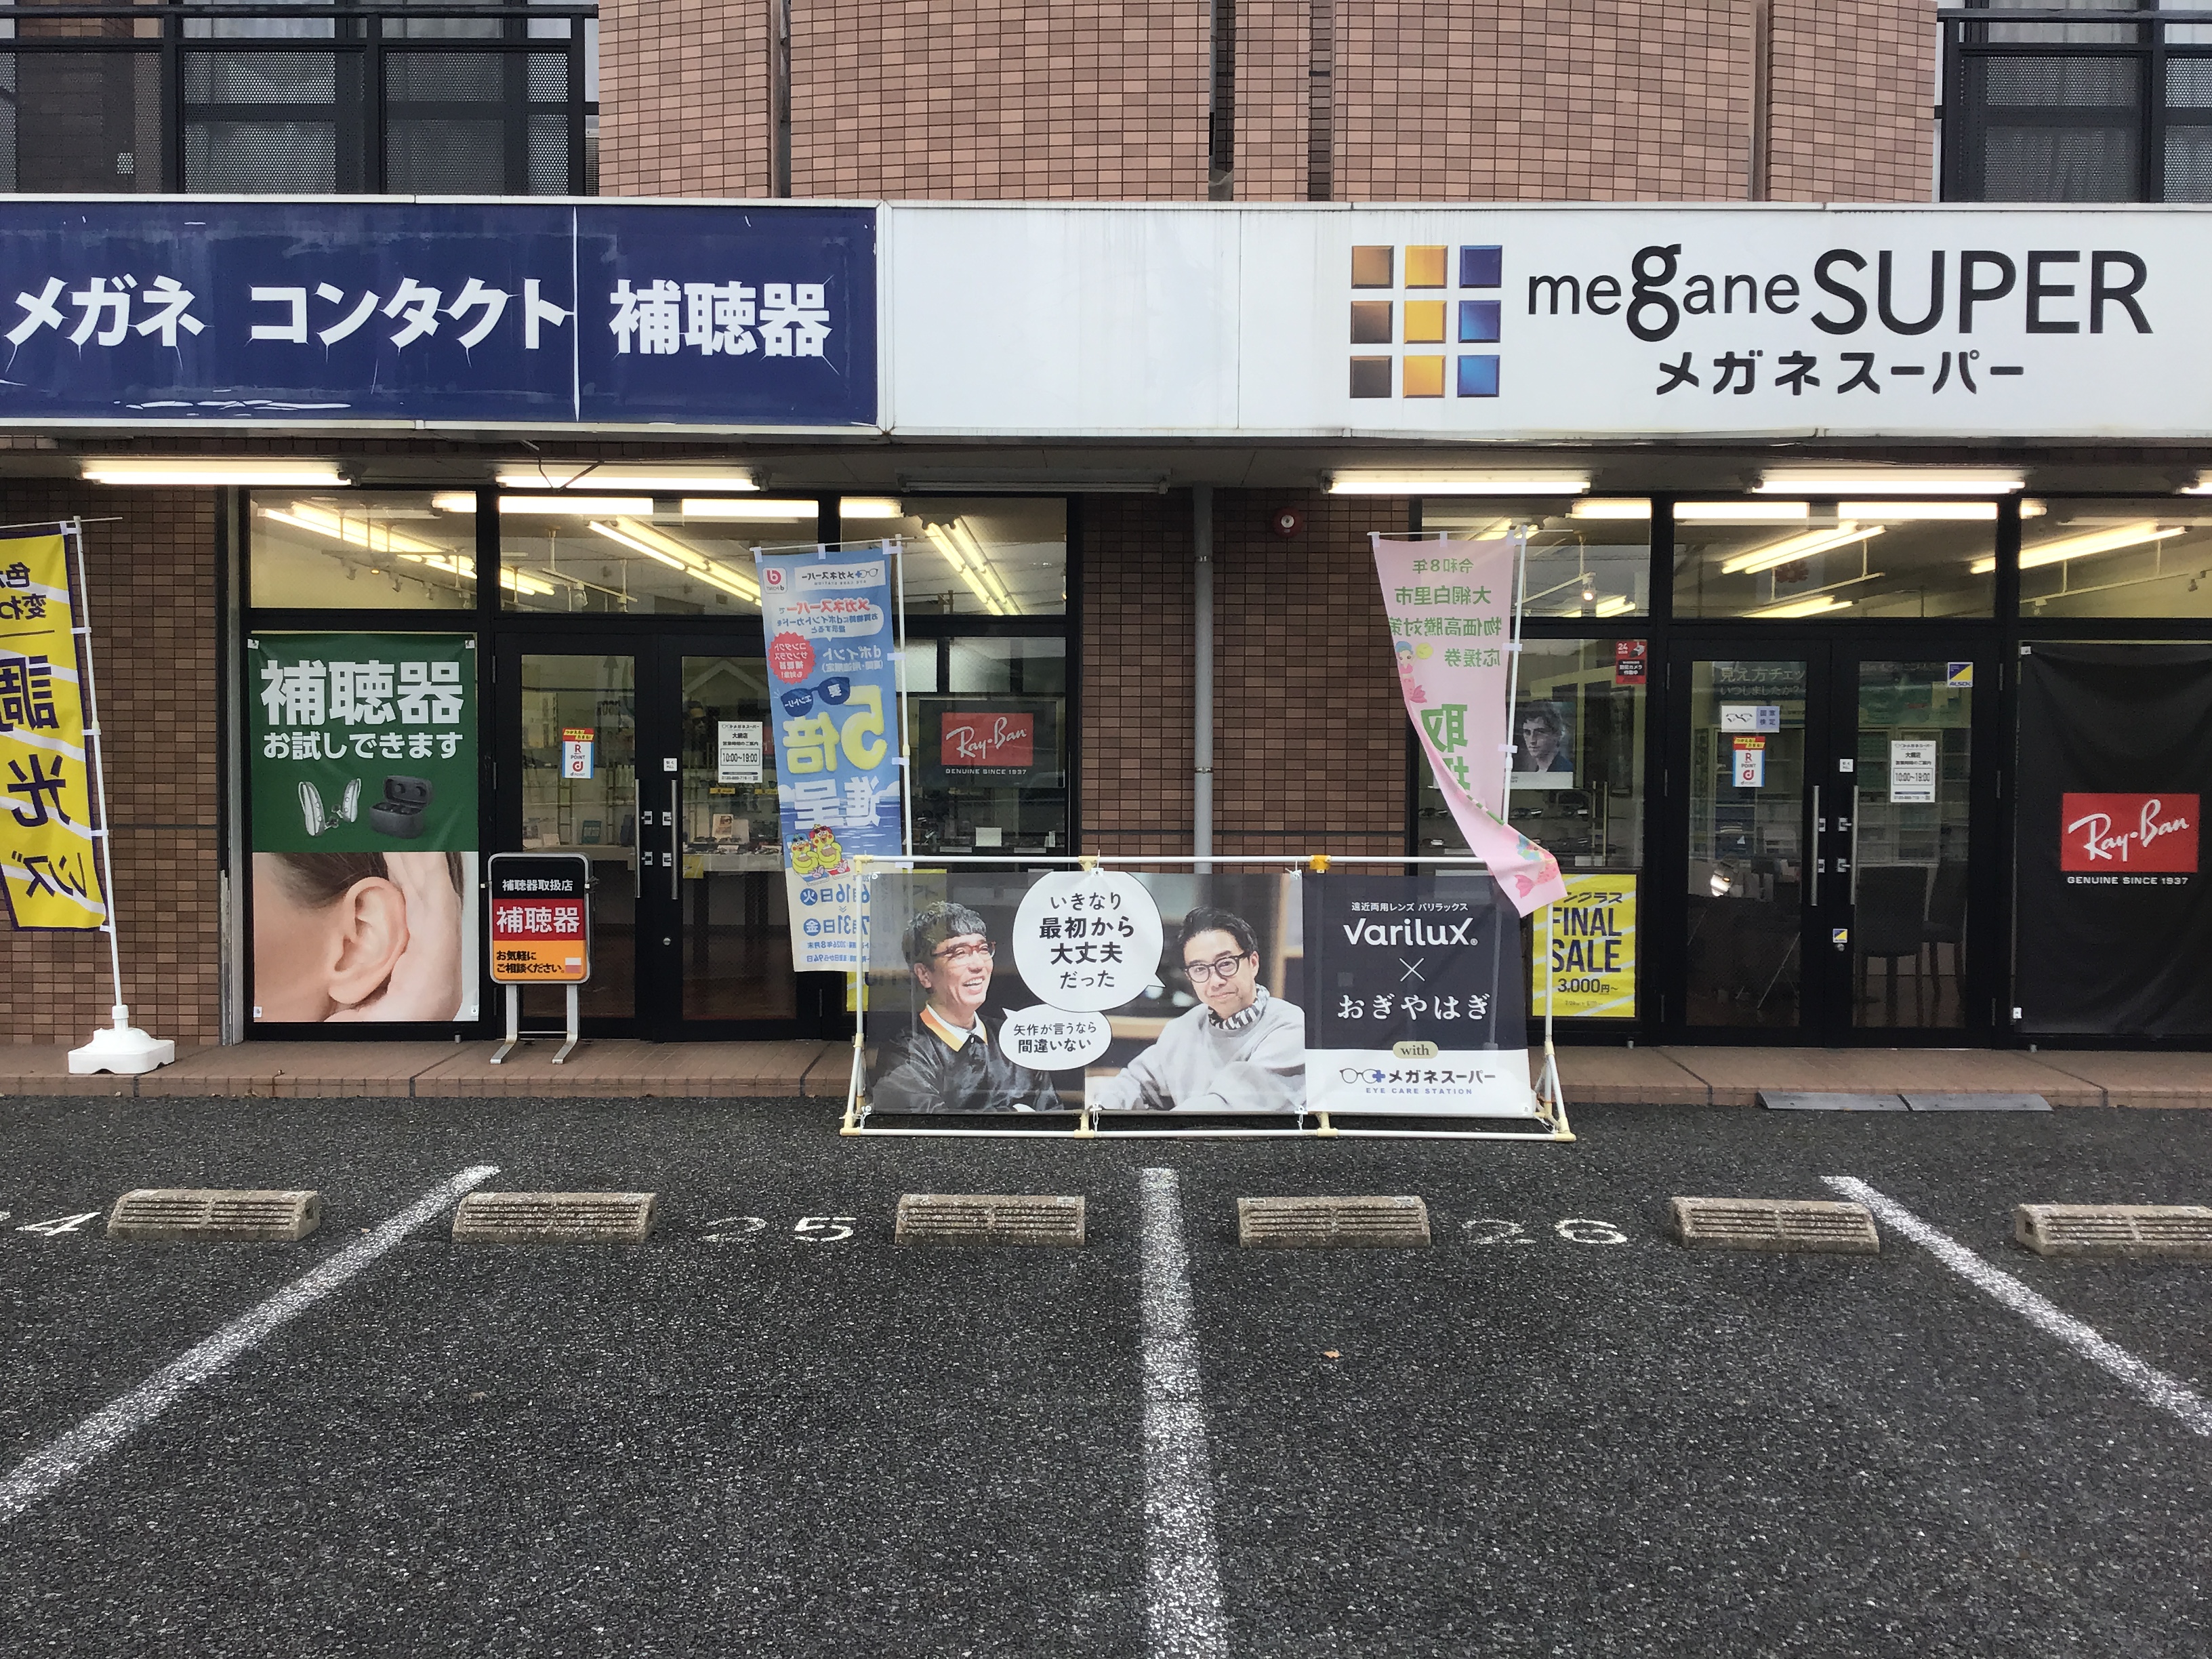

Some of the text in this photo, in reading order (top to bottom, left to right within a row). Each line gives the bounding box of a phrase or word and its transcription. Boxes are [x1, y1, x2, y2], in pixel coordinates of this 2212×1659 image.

[1528, 243, 2154, 343] megane SUPER
[5, 274, 833, 357] メガネ コンタクト 補聴器
[1656, 350, 2024, 396] メガネスーパー
[260, 659, 464, 726] 補聴器
[264, 731, 463, 760] お試しできます
[501, 880, 573, 892] 補聴器取扱店
[2067, 876, 2118, 884] GENUINE
[2123, 877, 2158, 885] SINCE
[1050, 892, 1121, 911] いきなり
[1563, 891, 1622, 903] ングラス
[1351, 902, 1469, 912] 遠近両用レンズ バリラックス
[496, 906, 580, 933] 補聴器
[1039, 916, 1134, 939] 最初から
[496, 950, 537, 961] お気軽に
[1050, 941, 1123, 965] 大丈夫
[1552, 939, 1622, 972] SALE
[1060, 970, 1115, 989] だった
[1337, 993, 1490, 1021] おぎやはぎ
[1013, 1022, 1097, 1036] 矢作が言うなら
[1018, 1038, 1092, 1054] 間違いない
[1400, 1046, 1430, 1056] with
[1388, 1069, 1496, 1084] メガネスーパー
[1425, 1087, 1473, 1095] STATION
